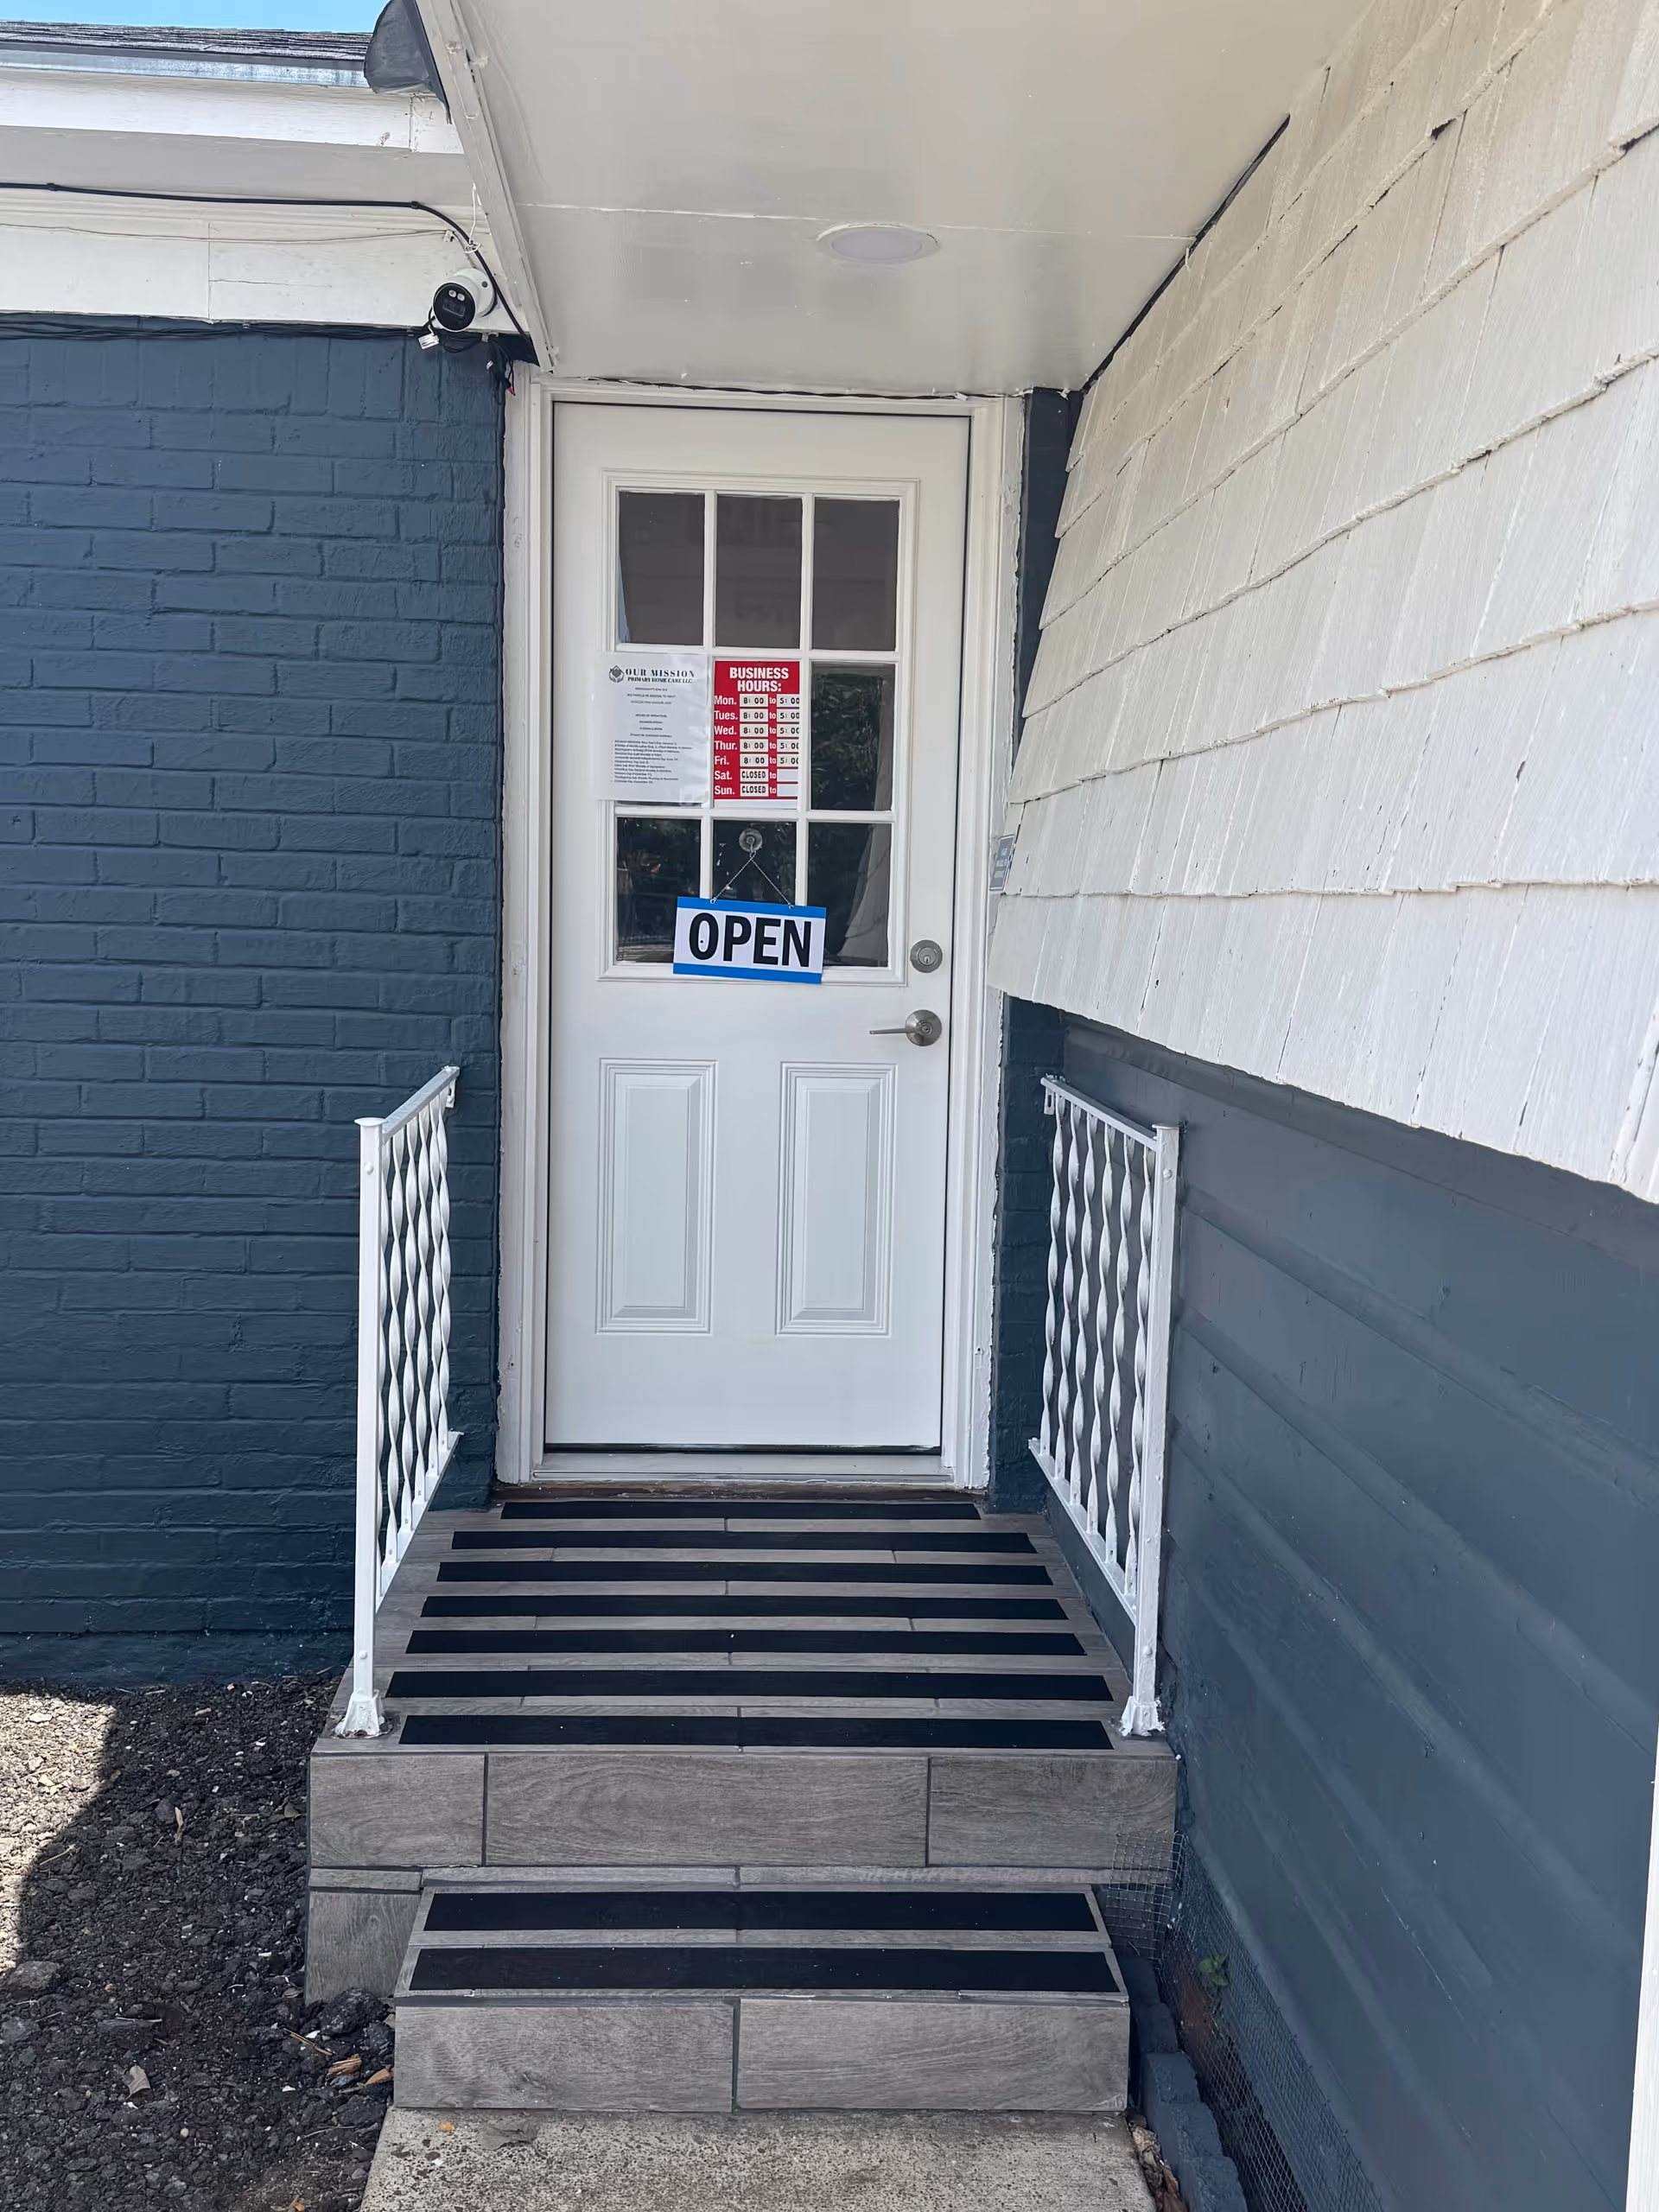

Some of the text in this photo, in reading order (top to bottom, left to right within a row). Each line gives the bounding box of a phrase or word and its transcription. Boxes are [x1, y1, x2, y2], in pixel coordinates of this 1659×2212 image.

[626, 668, 695, 677] OUR MISSION
[729, 667, 789, 679] BUSINESS
[737, 680, 782, 692] HOURS:
[715, 695, 737, 705] Mon.
[715, 710, 738, 720] Tues.
[715, 726, 737, 734] Wed.
[715, 741, 737, 750] Thur.
[715, 755, 729, 765] Fri.
[715, 770, 732, 779] Sat.
[715, 785, 734, 795] Sun.
[689, 912, 812, 968] OPEN
